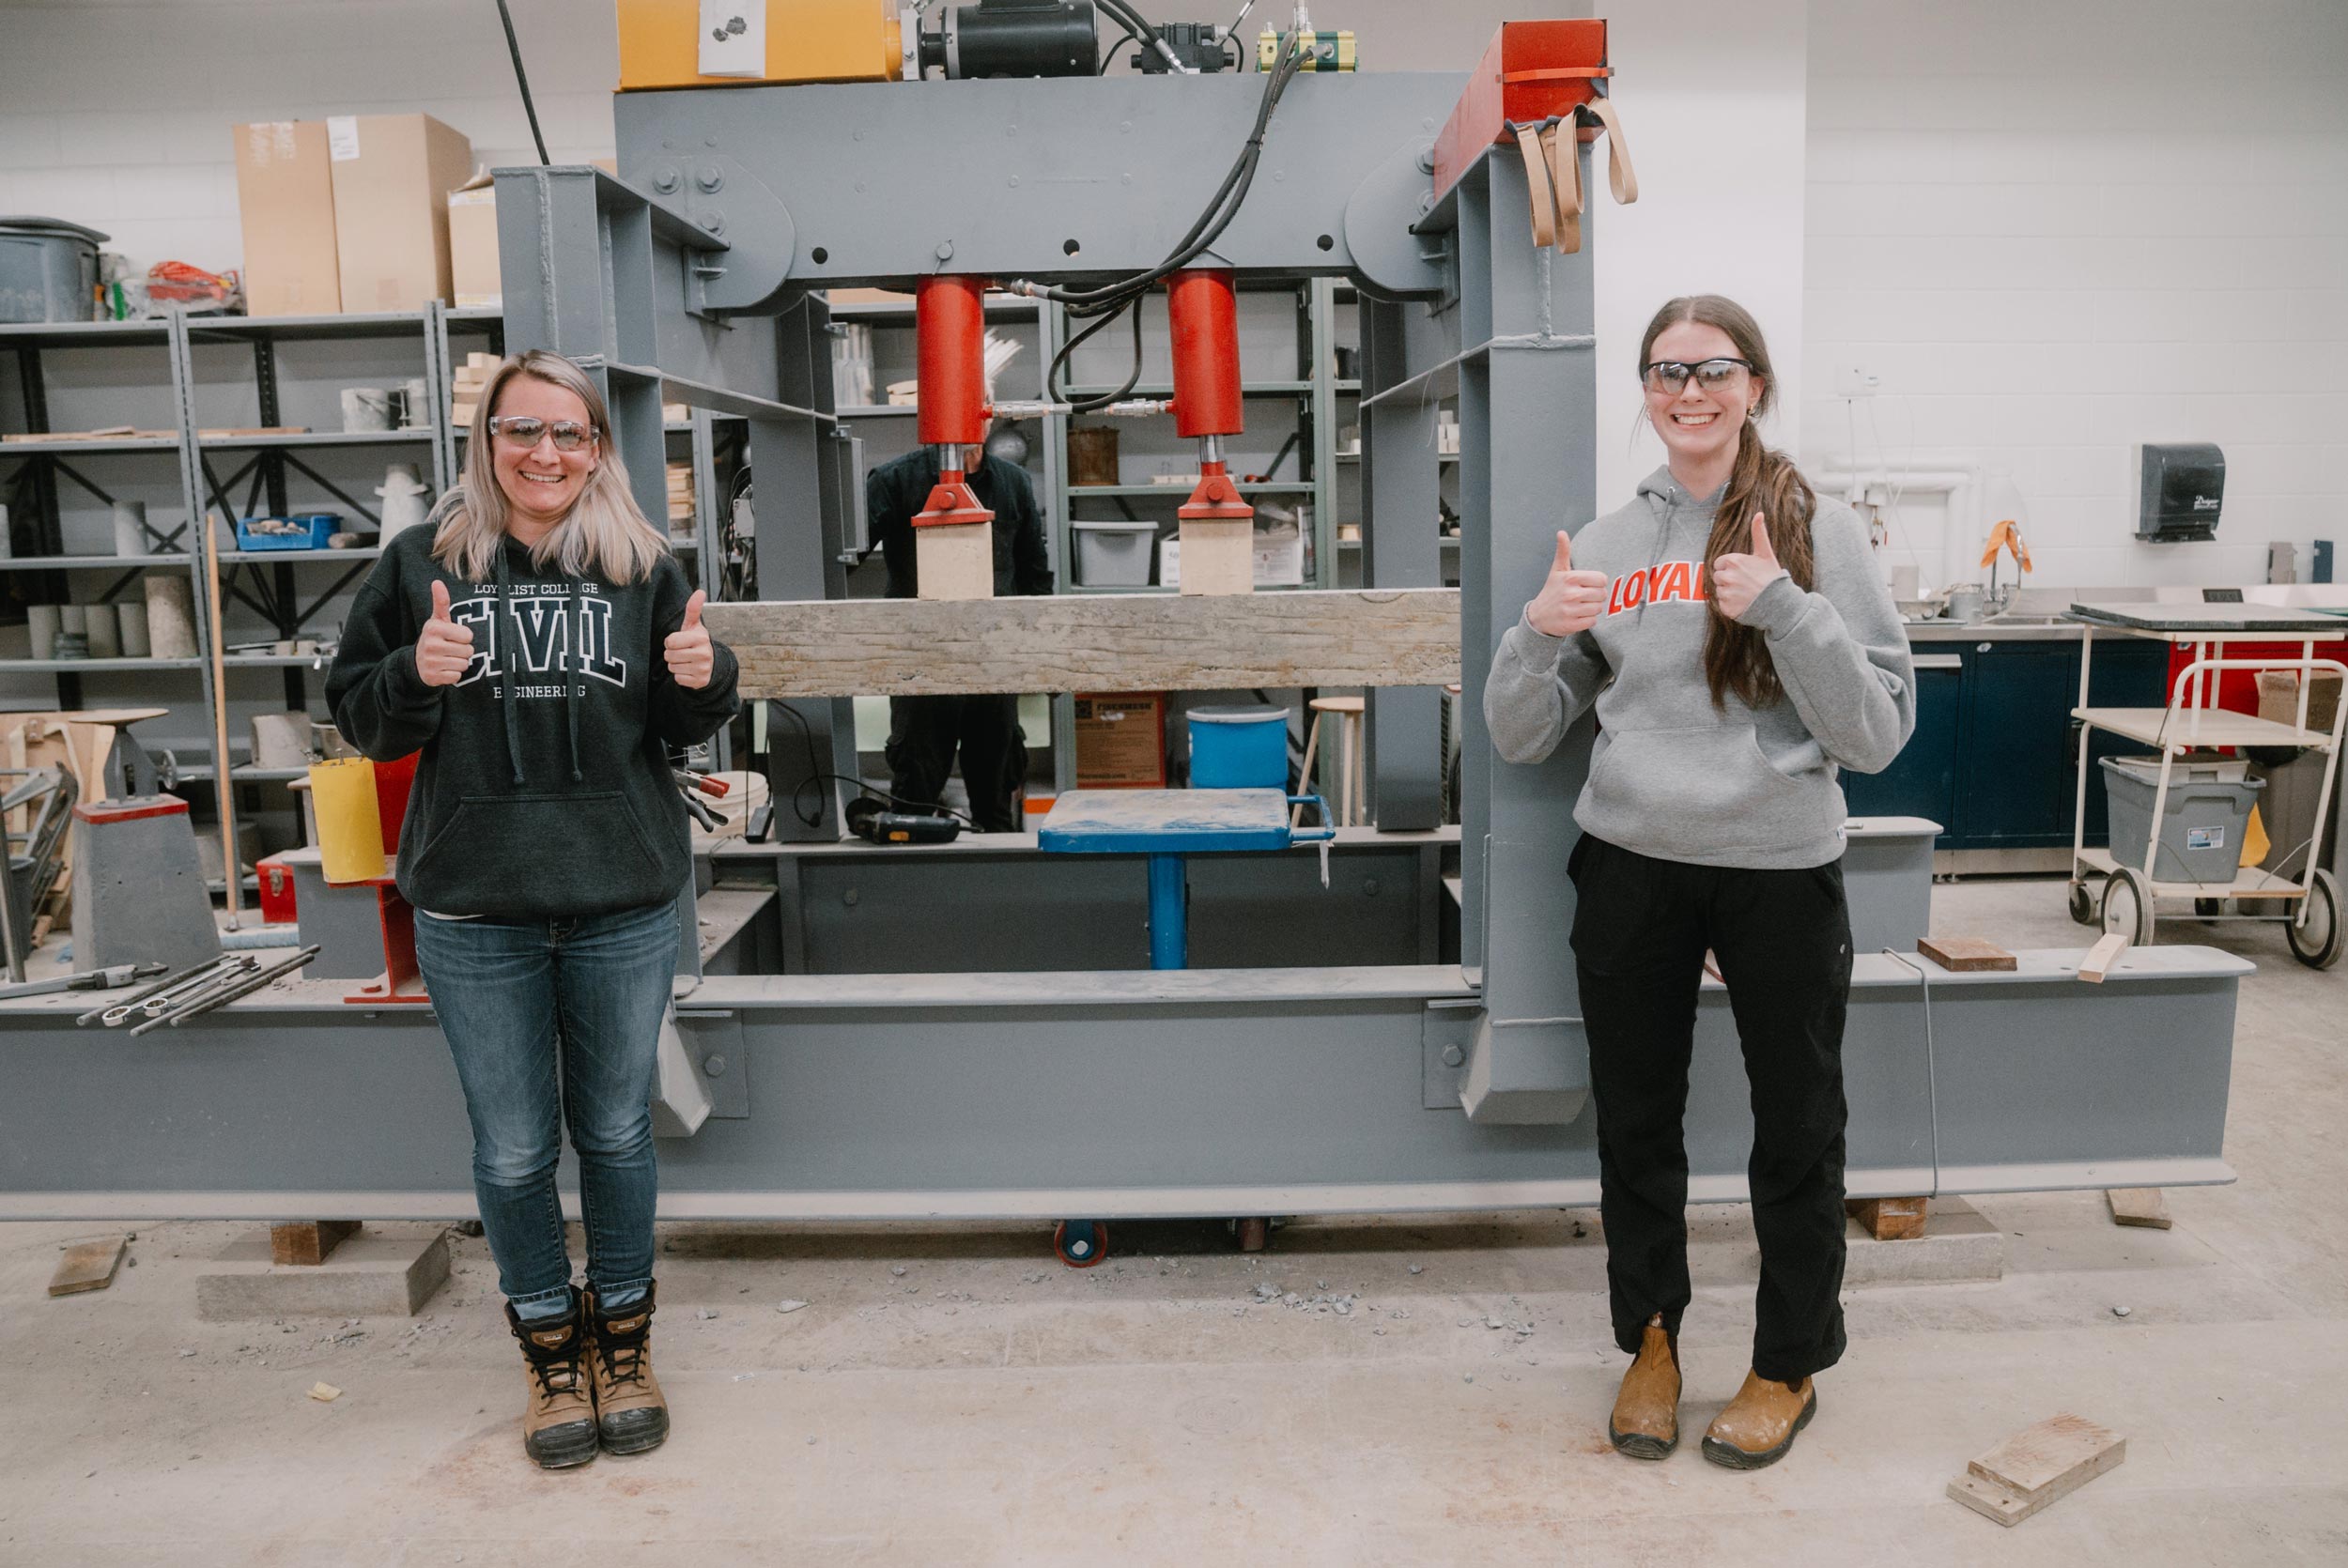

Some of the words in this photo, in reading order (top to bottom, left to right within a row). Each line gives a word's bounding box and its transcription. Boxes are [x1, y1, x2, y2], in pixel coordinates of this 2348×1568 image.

[474, 584, 536, 595] LOYLIST
[540, 583, 599, 594] COLLGE
[493, 685, 586, 699] EGINEERIG
